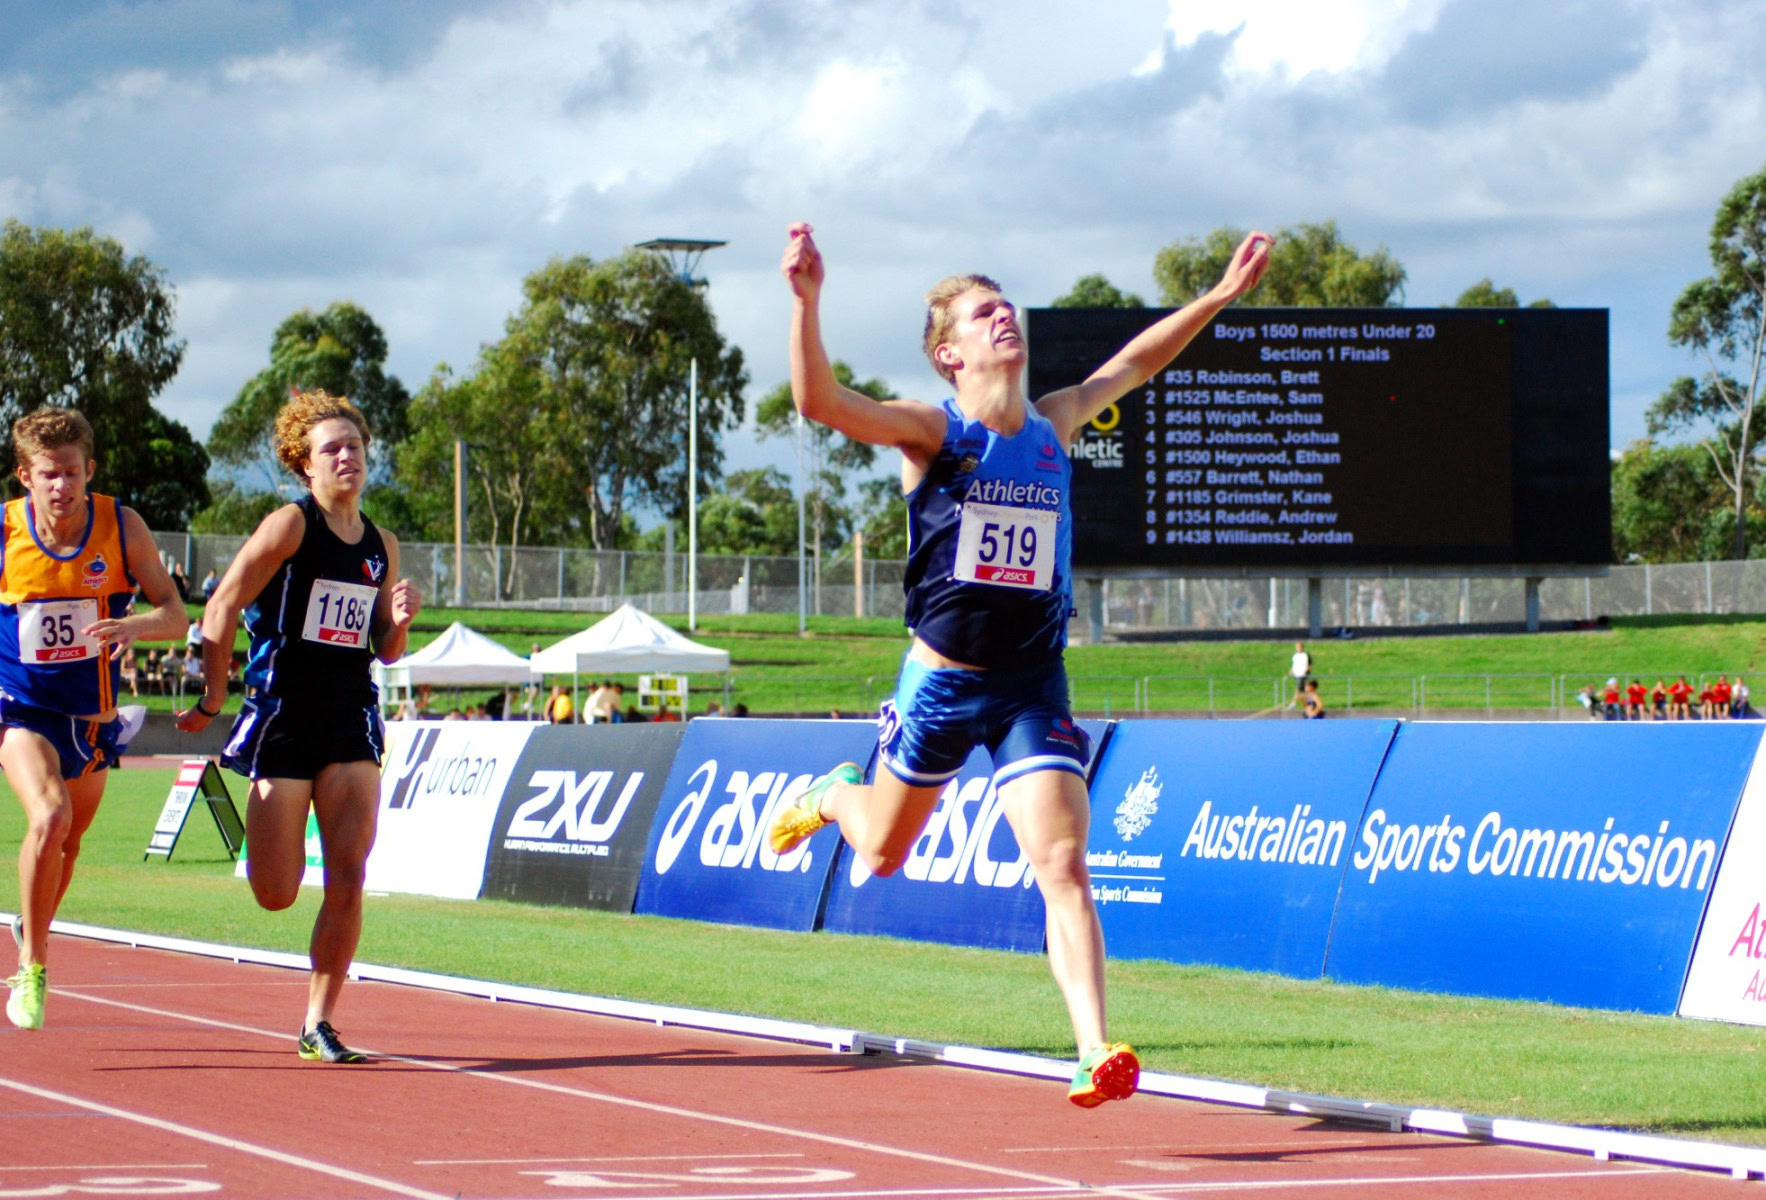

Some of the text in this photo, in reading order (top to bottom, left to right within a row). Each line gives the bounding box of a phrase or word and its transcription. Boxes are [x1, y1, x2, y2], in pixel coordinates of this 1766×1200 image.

[1214, 323, 1435, 341] Boys 1500 metres Under 20
[1260, 346, 1390, 362] Section 1 Finals
[1165, 370, 1192, 385] #35
[1197, 370, 1276, 386] Robinson,
[1281, 370, 1319, 385] Brett
[1146, 390, 1323, 406] 2 #1525 McEntee, Sam
[1146, 411, 1322, 427] 3 #546 Wright, Joshua
[1146, 430, 1339, 446] 4 #305 Johnson, Joshua
[1146, 450, 1340, 467] 5 #1500 Heywood, Ethan
[1146, 470, 1323, 486] 6 #557 Barrett, Nathan
[964, 479, 1060, 505] Athletics
[1146, 490, 1332, 505] 7 #1185 Grimster, Kane
[1146, 510, 1338, 525] 8 #1354 Reddie, Andrew
[979, 522, 1037, 567] 519
[1146, 530, 1353, 544] 9 #1438 Williamsz, Jordan
[319, 593, 367, 631] 1185
[41, 614, 75, 647] 35
[427, 740, 496, 796] urban
[1181, 800, 1717, 890] Australian Sports Commission
[1728, 902, 1766, 959] At
